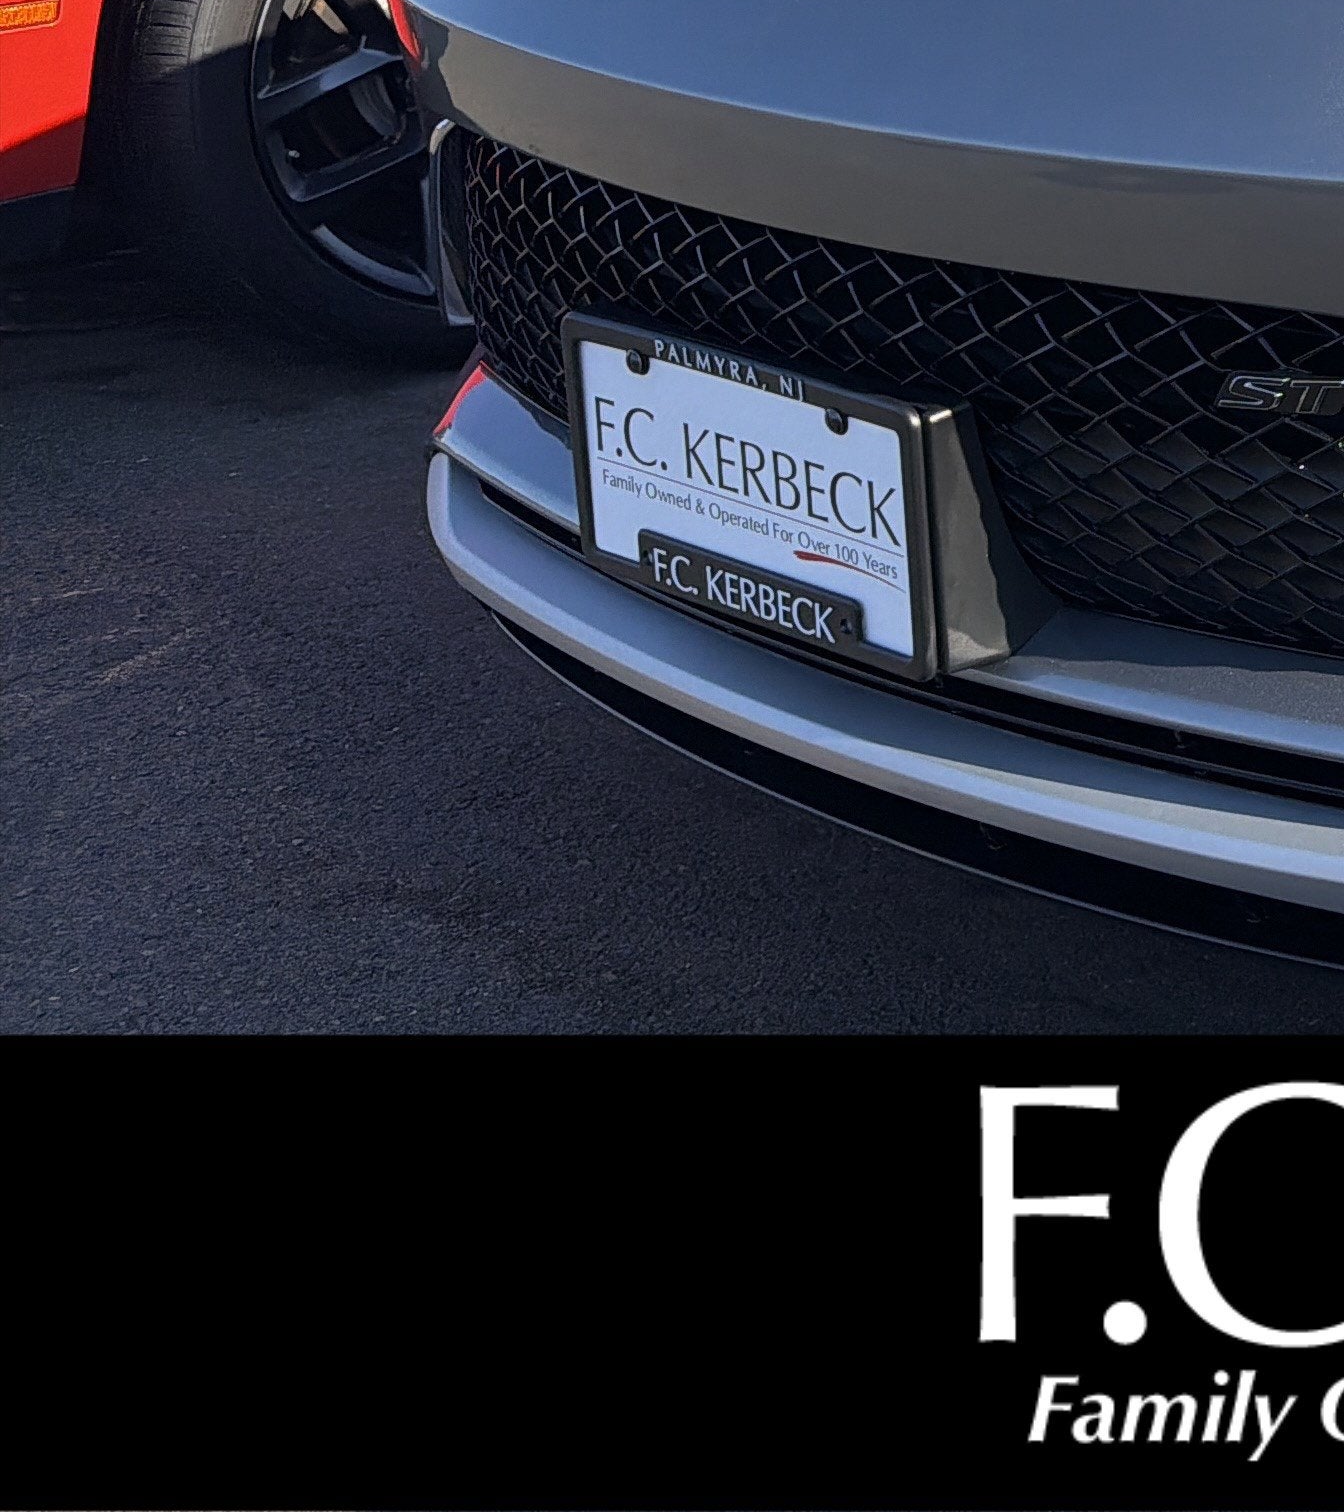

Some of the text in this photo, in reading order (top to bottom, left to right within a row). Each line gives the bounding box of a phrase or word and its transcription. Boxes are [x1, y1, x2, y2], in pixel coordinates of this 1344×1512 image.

[654, 339, 767, 392] PALMYRA,
[594, 395, 902, 547] F.C. KERBECK
[602, 468, 898, 580] Family Owned & Operated For Over 100 Years
[652, 547, 836, 644] F.C. KERBECK
